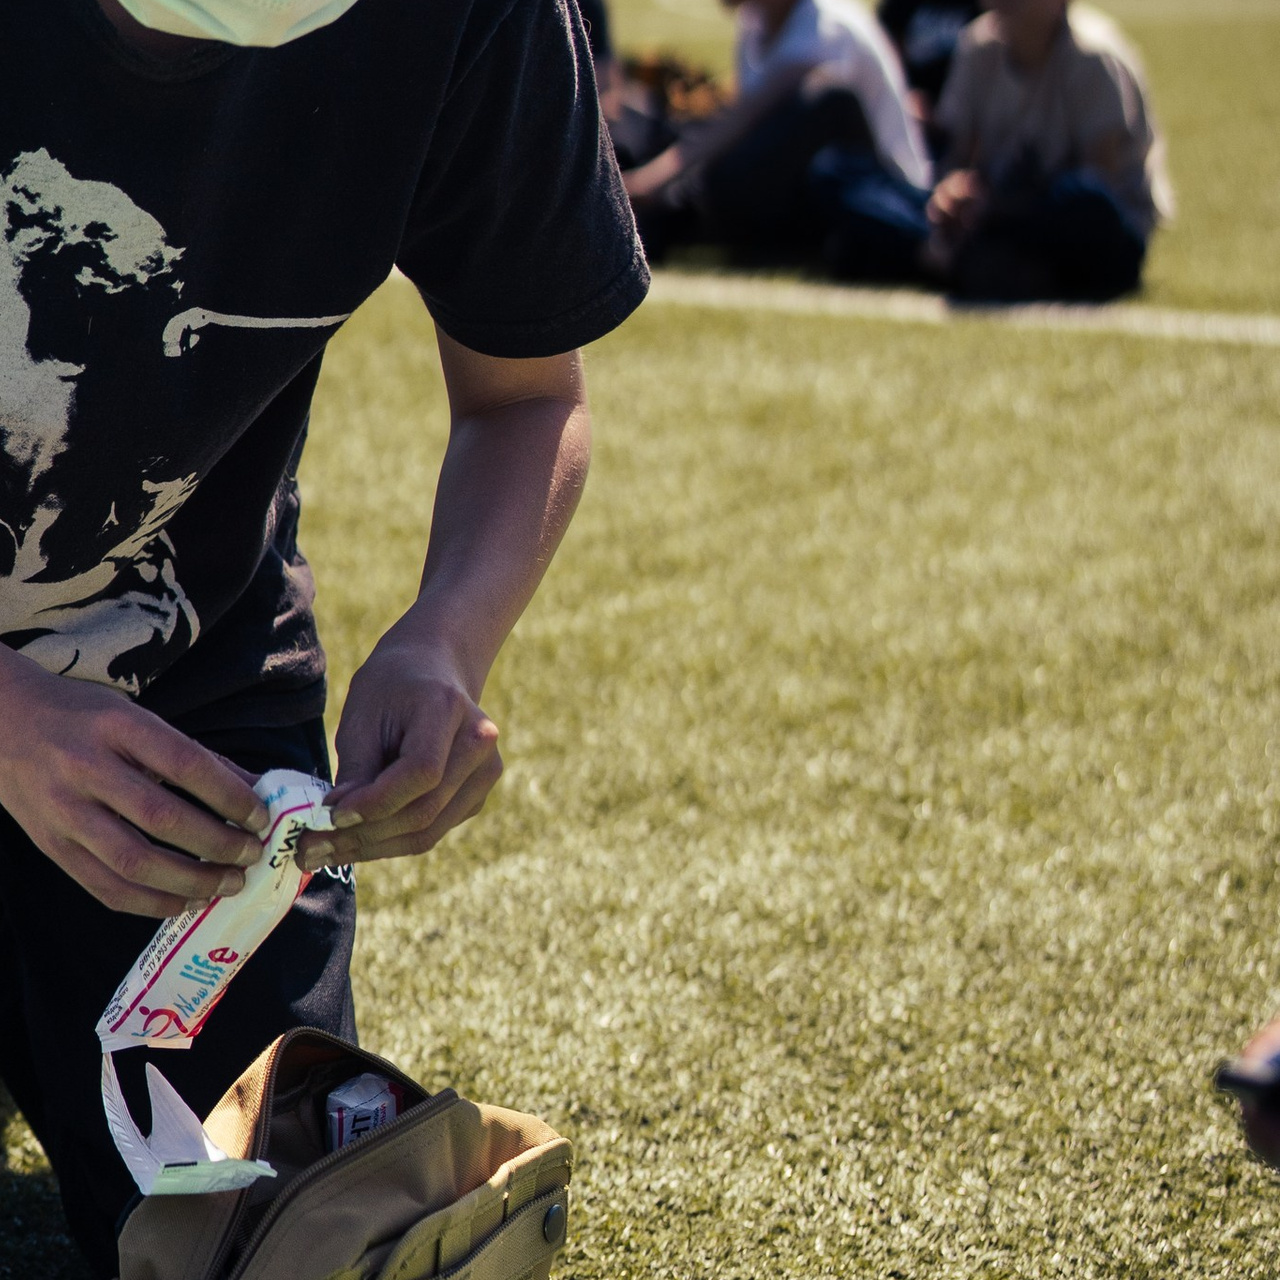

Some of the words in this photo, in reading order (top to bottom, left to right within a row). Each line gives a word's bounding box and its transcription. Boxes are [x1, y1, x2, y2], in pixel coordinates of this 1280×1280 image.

[138, 939, 158, 971] БИНТЫ
[179, 946, 239, 988] life
[173, 987, 210, 1019] New
